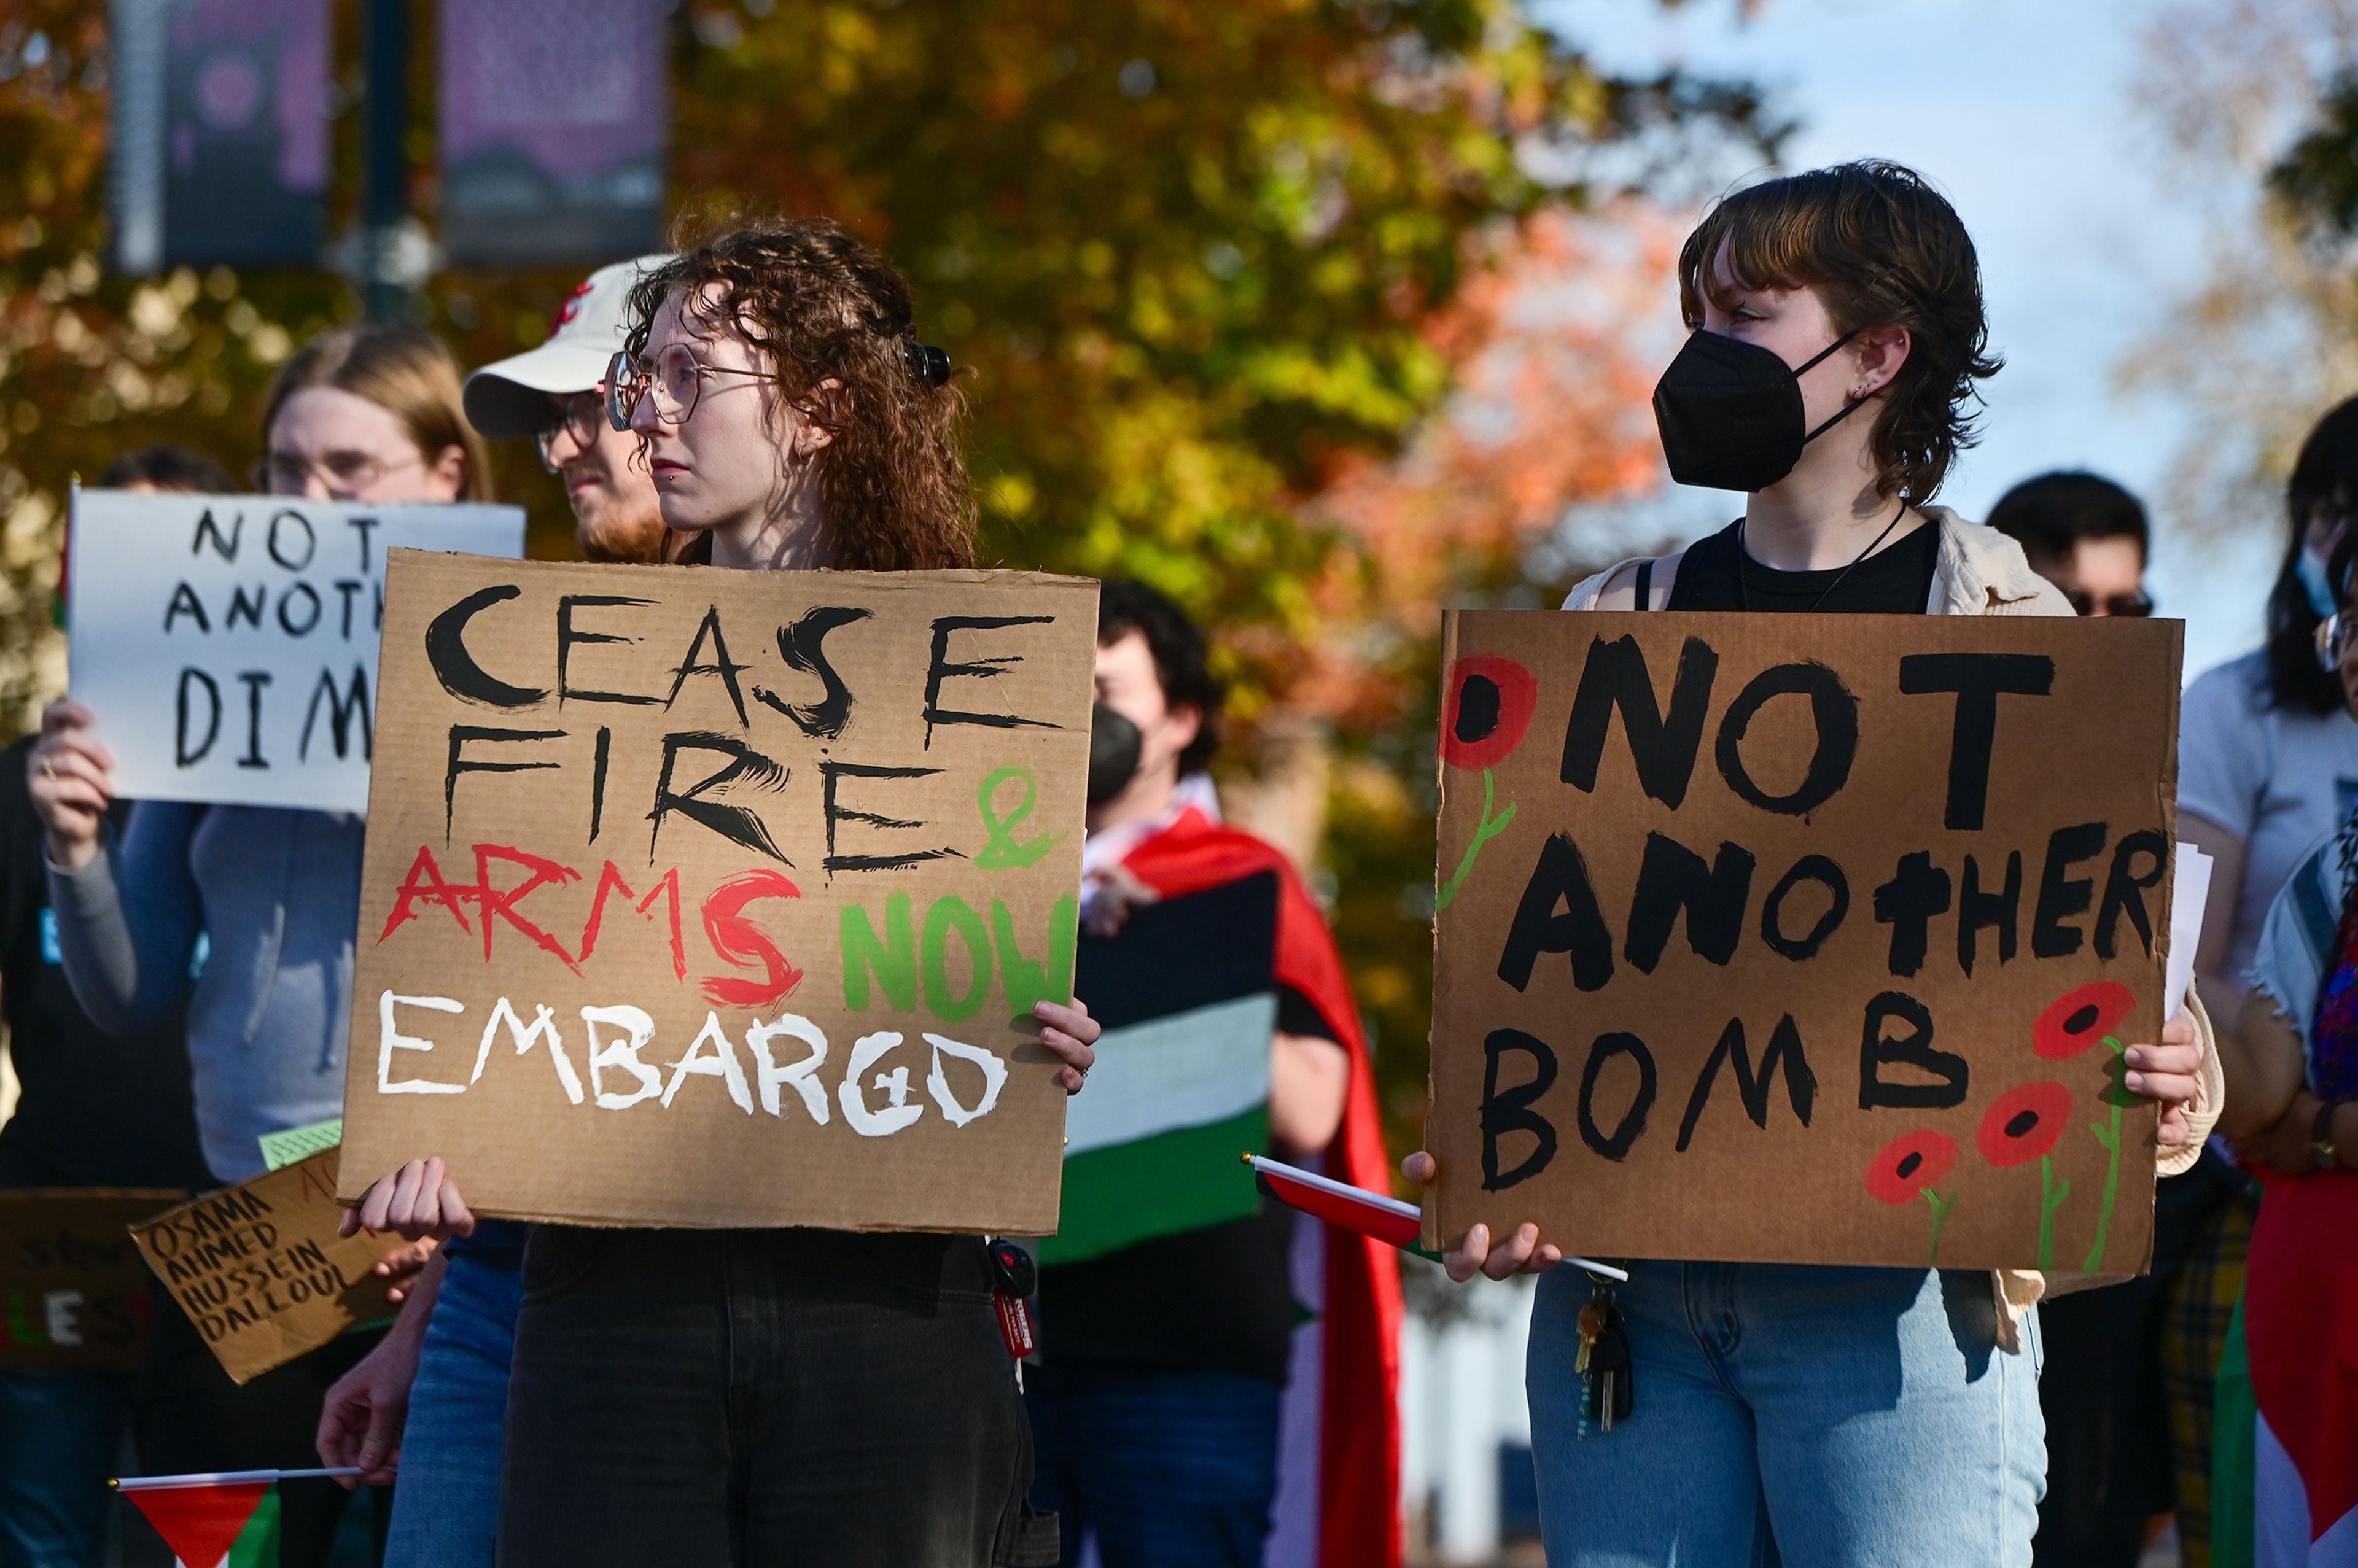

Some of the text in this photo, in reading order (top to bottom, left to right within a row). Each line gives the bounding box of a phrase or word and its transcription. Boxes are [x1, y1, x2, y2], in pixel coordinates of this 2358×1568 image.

[192, 508, 379, 574] NOT
[424, 584, 1065, 750] CEASE
[1560, 632, 2056, 831] NOT
[444, 724, 1072, 887] FIRE &
[376, 842, 1078, 1022] ARMS NOW
[1497, 821, 2168, 993] ANOTHER
[1478, 990, 1969, 1192] BOMB
[150, 1189, 274, 1259] OSAMA
[166, 1222, 278, 1286] AHMED
[181, 1238, 328, 1316] HUSSEIN
